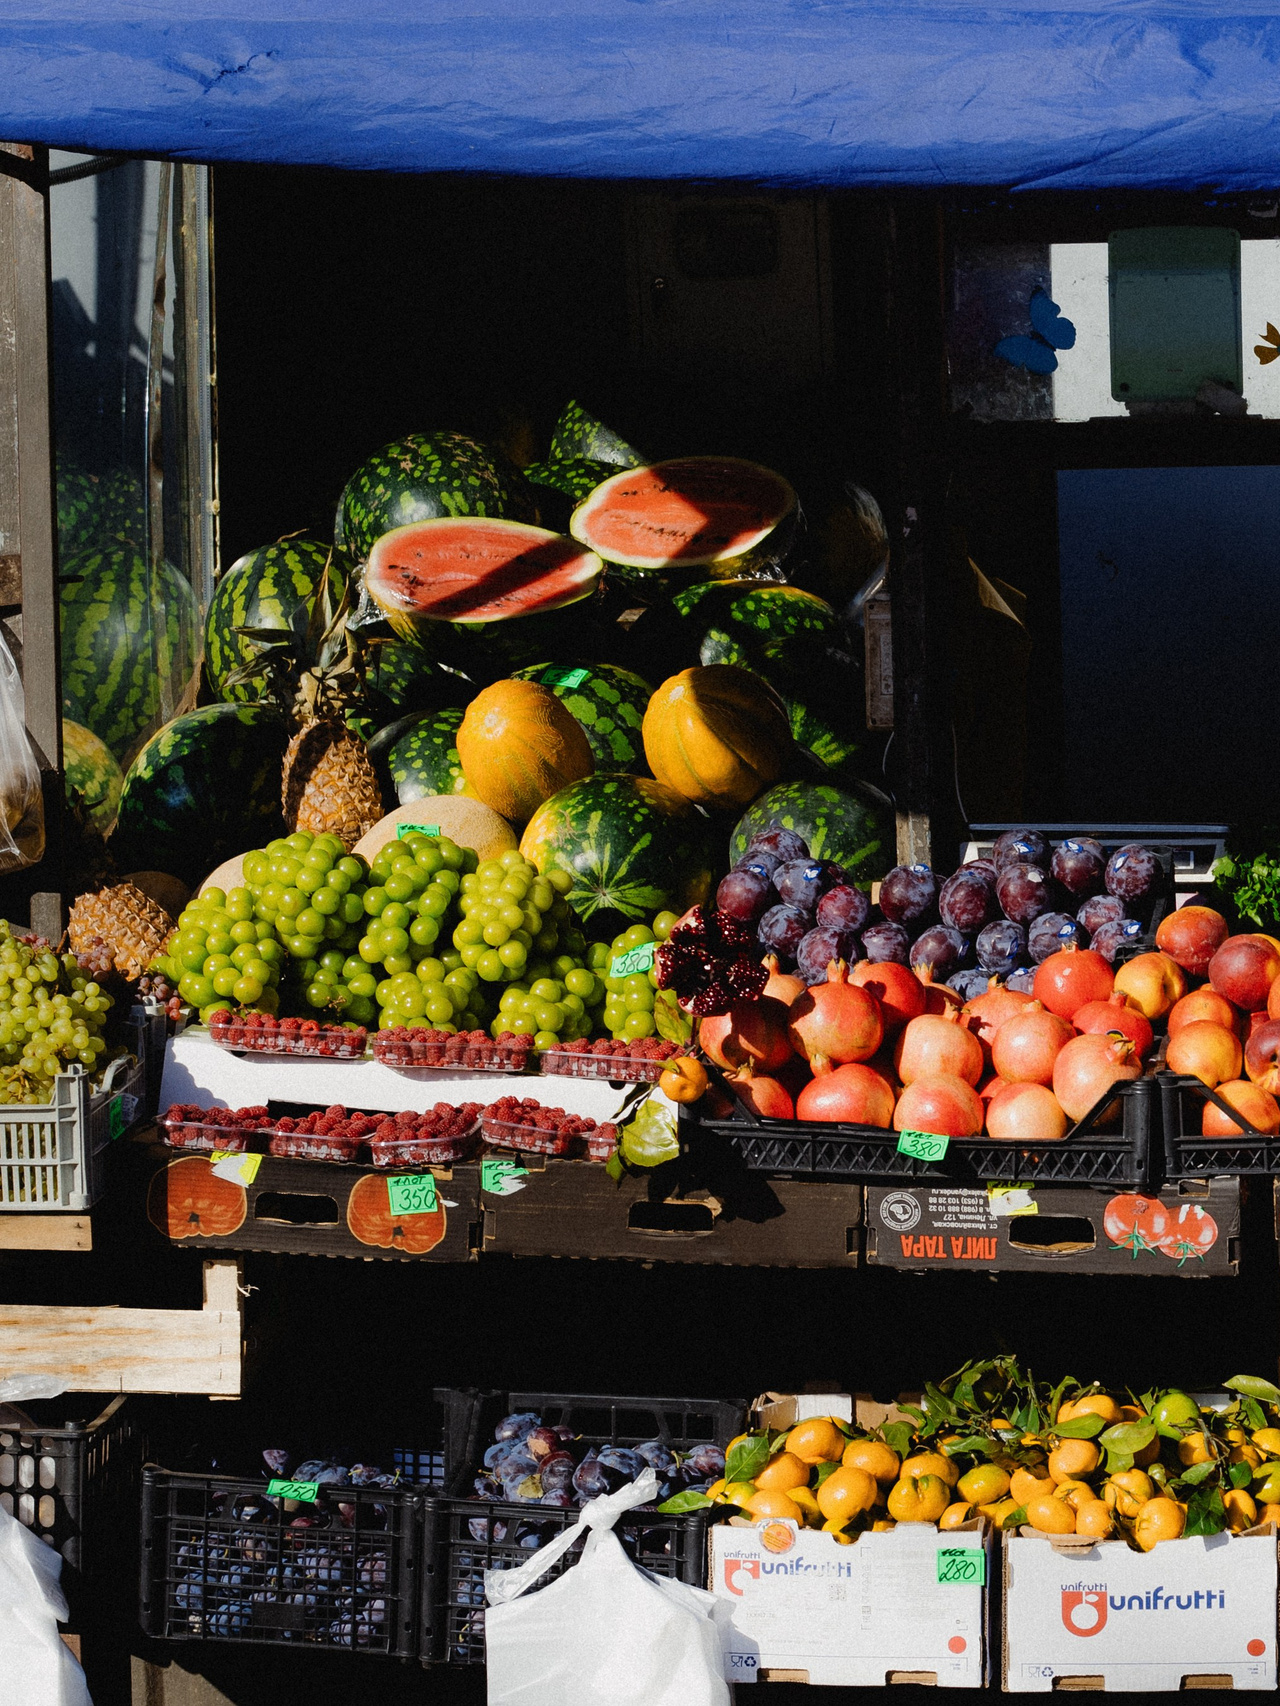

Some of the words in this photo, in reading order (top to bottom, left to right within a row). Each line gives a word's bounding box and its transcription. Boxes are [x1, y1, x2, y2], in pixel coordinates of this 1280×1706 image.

[616, 952, 651, 974] 380
[903, 1139, 942, 1157] 380
[399, 1186, 436, 1211] 350
[961, 1197, 978, 1205] (953)
[928, 1204, 937, 1212] 32
[932, 1220, 986, 1230] Михайловская,
[958, 1213, 986, 1222] Ленина,
[900, 1234, 947, 1258] ТАРА
[950, 1236, 998, 1260] ЛИГА
[724, 1550, 760, 1559] unifrutti
[939, 1558, 976, 1582] 280
[1061, 1581, 1107, 1591] unifrutti
[1109, 1586, 1225, 1611] unifrutti
